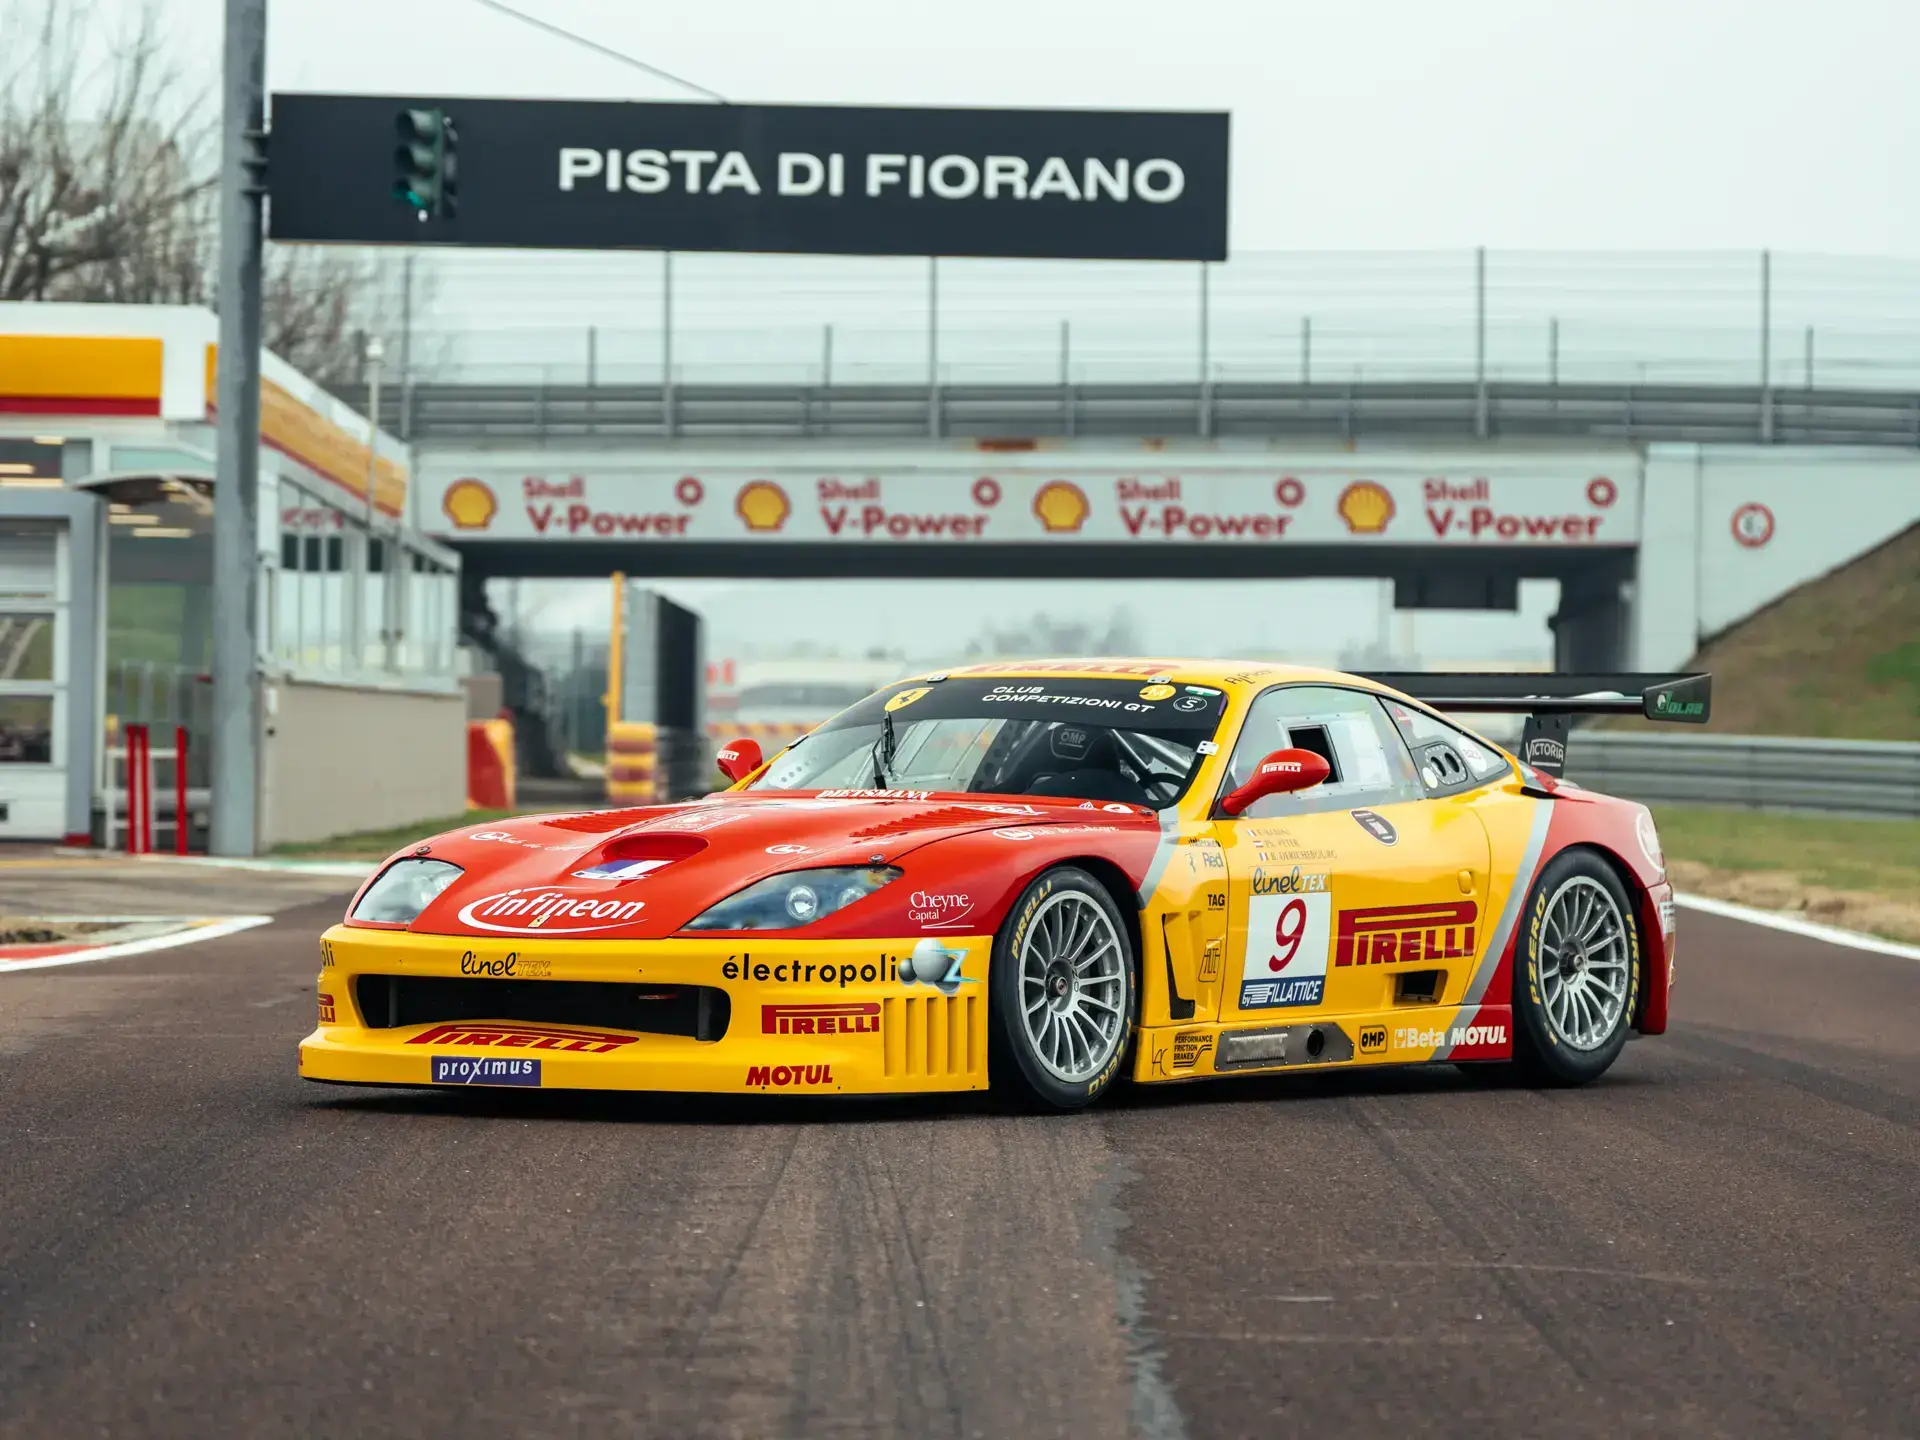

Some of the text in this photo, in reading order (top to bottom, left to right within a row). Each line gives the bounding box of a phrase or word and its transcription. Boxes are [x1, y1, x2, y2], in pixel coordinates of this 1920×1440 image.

[558, 146, 1186, 204] PISTA DI FIORANO
[1115, 478, 1181, 502] Shell
[1423, 479, 1490, 503] Shell
[525, 503, 692, 536] V-Power
[819, 505, 989, 539] V-Power
[1119, 506, 1292, 540] V-Power
[1427, 507, 1602, 542] V-Power
[992, 686, 1045, 694] CLUB
[981, 694, 1156, 713] COMPETIZIONI GT
[1181, 700, 1199, 709] S
[1060, 731, 1086, 745] OMP
[1525, 738, 1565, 764] VICTORIA
[1261, 761, 1302, 774] PIRELLI
[482, 888, 645, 919] infineon
[910, 890, 969, 912] Cheyne
[1207, 894, 1225, 906] TAG
[908, 908, 939, 923] Capital
[1011, 879, 1052, 960] PIRELLI
[1268, 898, 1307, 973] 9
[1335, 900, 1478, 967] PIRELLI
[722, 952, 897, 988] électropoli
[1241, 980, 1322, 1006] by FILLATTICE
[761, 1003, 881, 1035] PIRELLI
[404, 1024, 640, 1053] PIRELLI
[1174, 1035, 1213, 1043] PERFORMANCE
[1174, 1044, 1198, 1052] FRICTION
[1361, 1032, 1385, 1047] OMP
[1406, 1027, 1446, 1048] Beta
[1450, 1026, 1507, 1046] MOTUL
[438, 1057, 533, 1085] proximus
[745, 1065, 833, 1085] MOTUL
